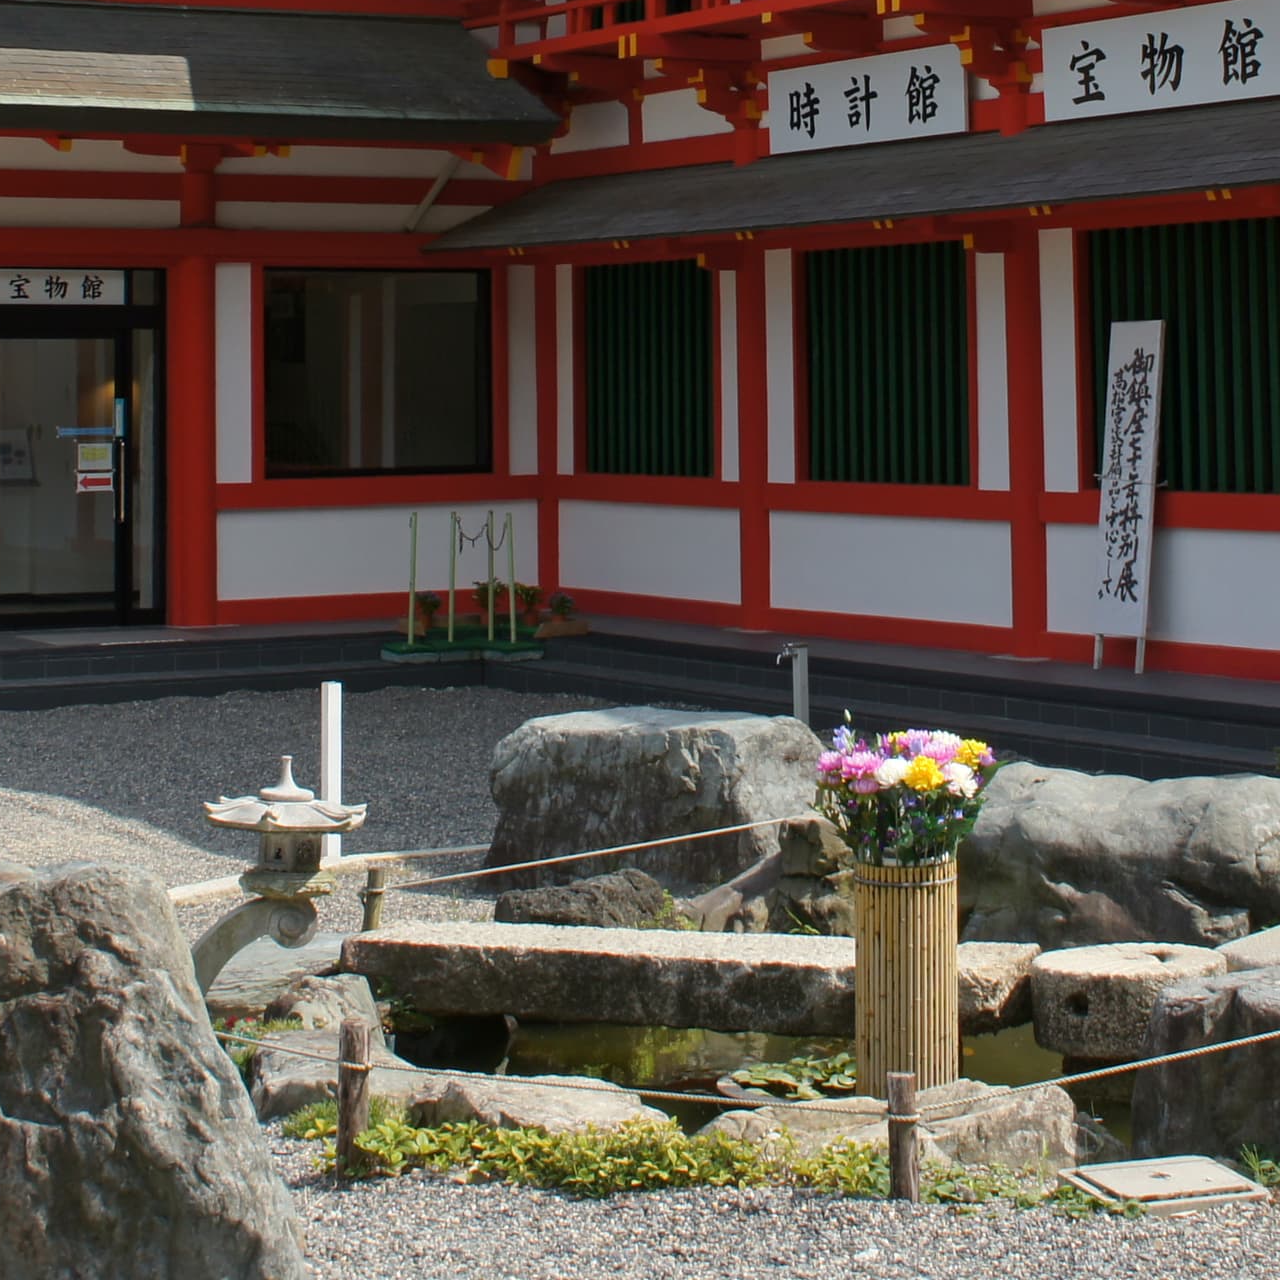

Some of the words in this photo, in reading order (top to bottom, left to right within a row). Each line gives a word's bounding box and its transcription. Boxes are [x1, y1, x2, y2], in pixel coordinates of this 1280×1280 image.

[1068, 18, 1265, 107] 宝物館
[788, 64, 942, 140] 時計館
[8, 275, 105, 301] 宝物館
